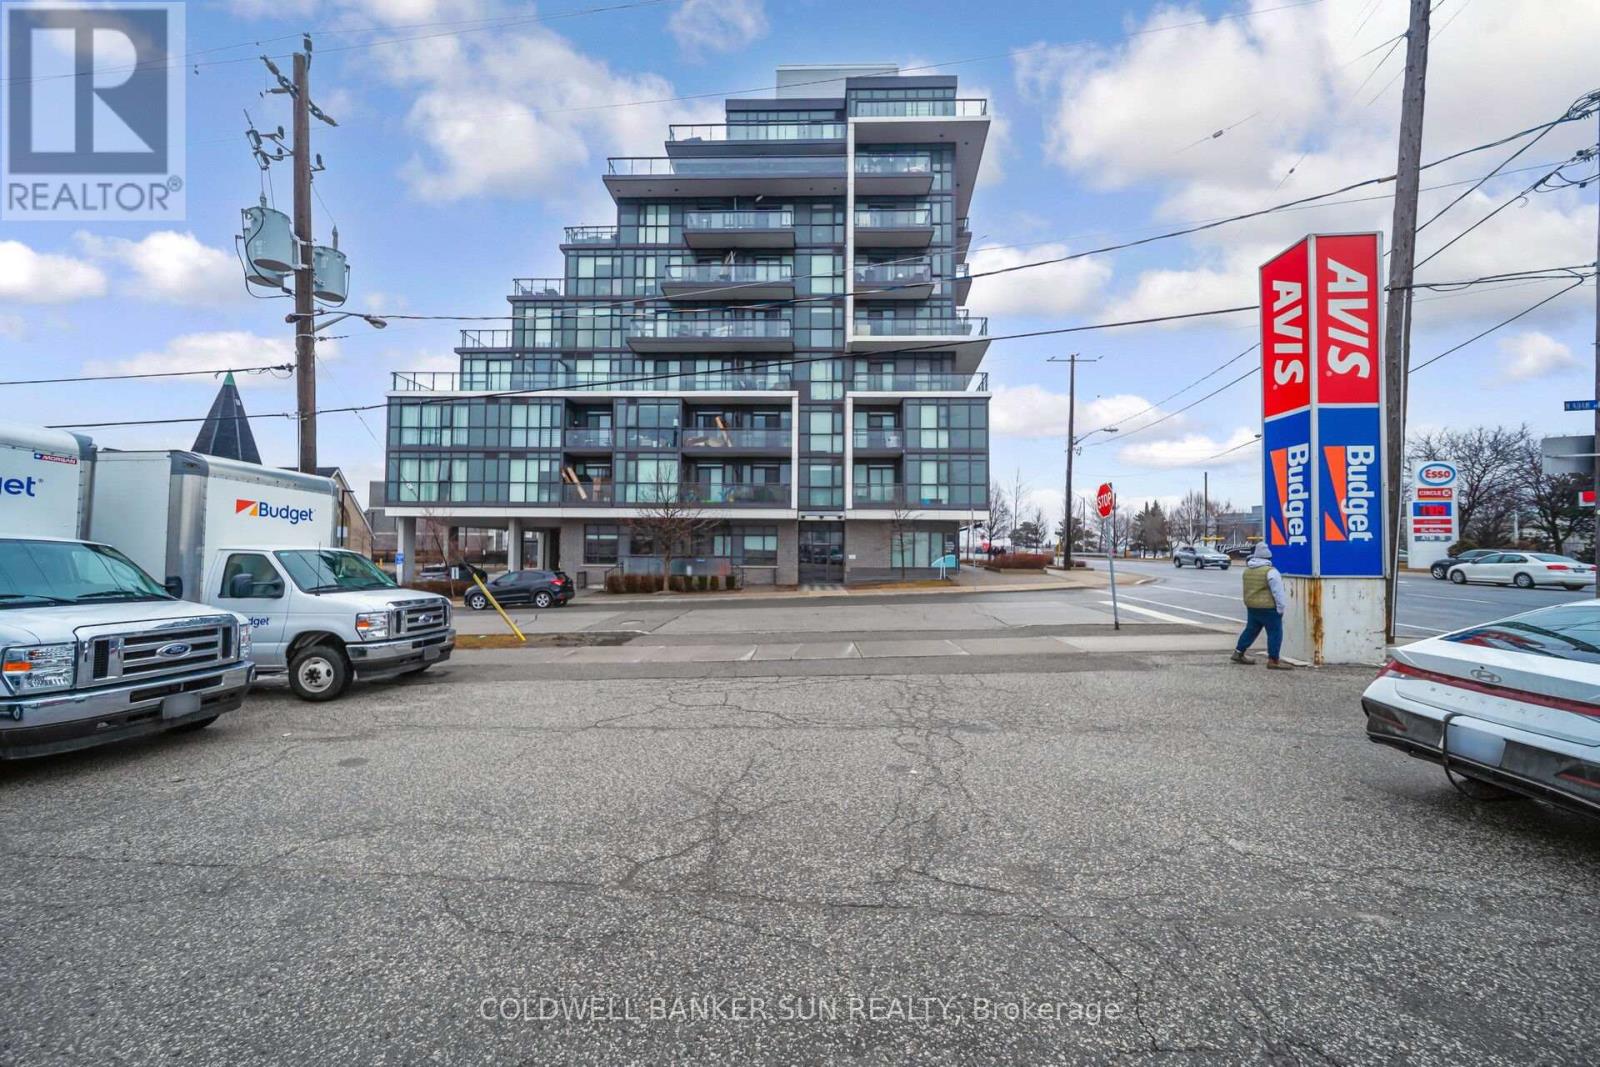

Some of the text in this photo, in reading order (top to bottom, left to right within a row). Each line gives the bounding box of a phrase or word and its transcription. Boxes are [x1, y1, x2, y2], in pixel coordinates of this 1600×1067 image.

[1272, 280, 1304, 386] AVIS
[1326, 257, 1371, 379] AVIS
[259, 501, 314, 525] Budget
[1098, 491, 1112, 509] STOP
[1283, 443, 1309, 546] Budget
[1341, 445, 1375, 542] Budget
